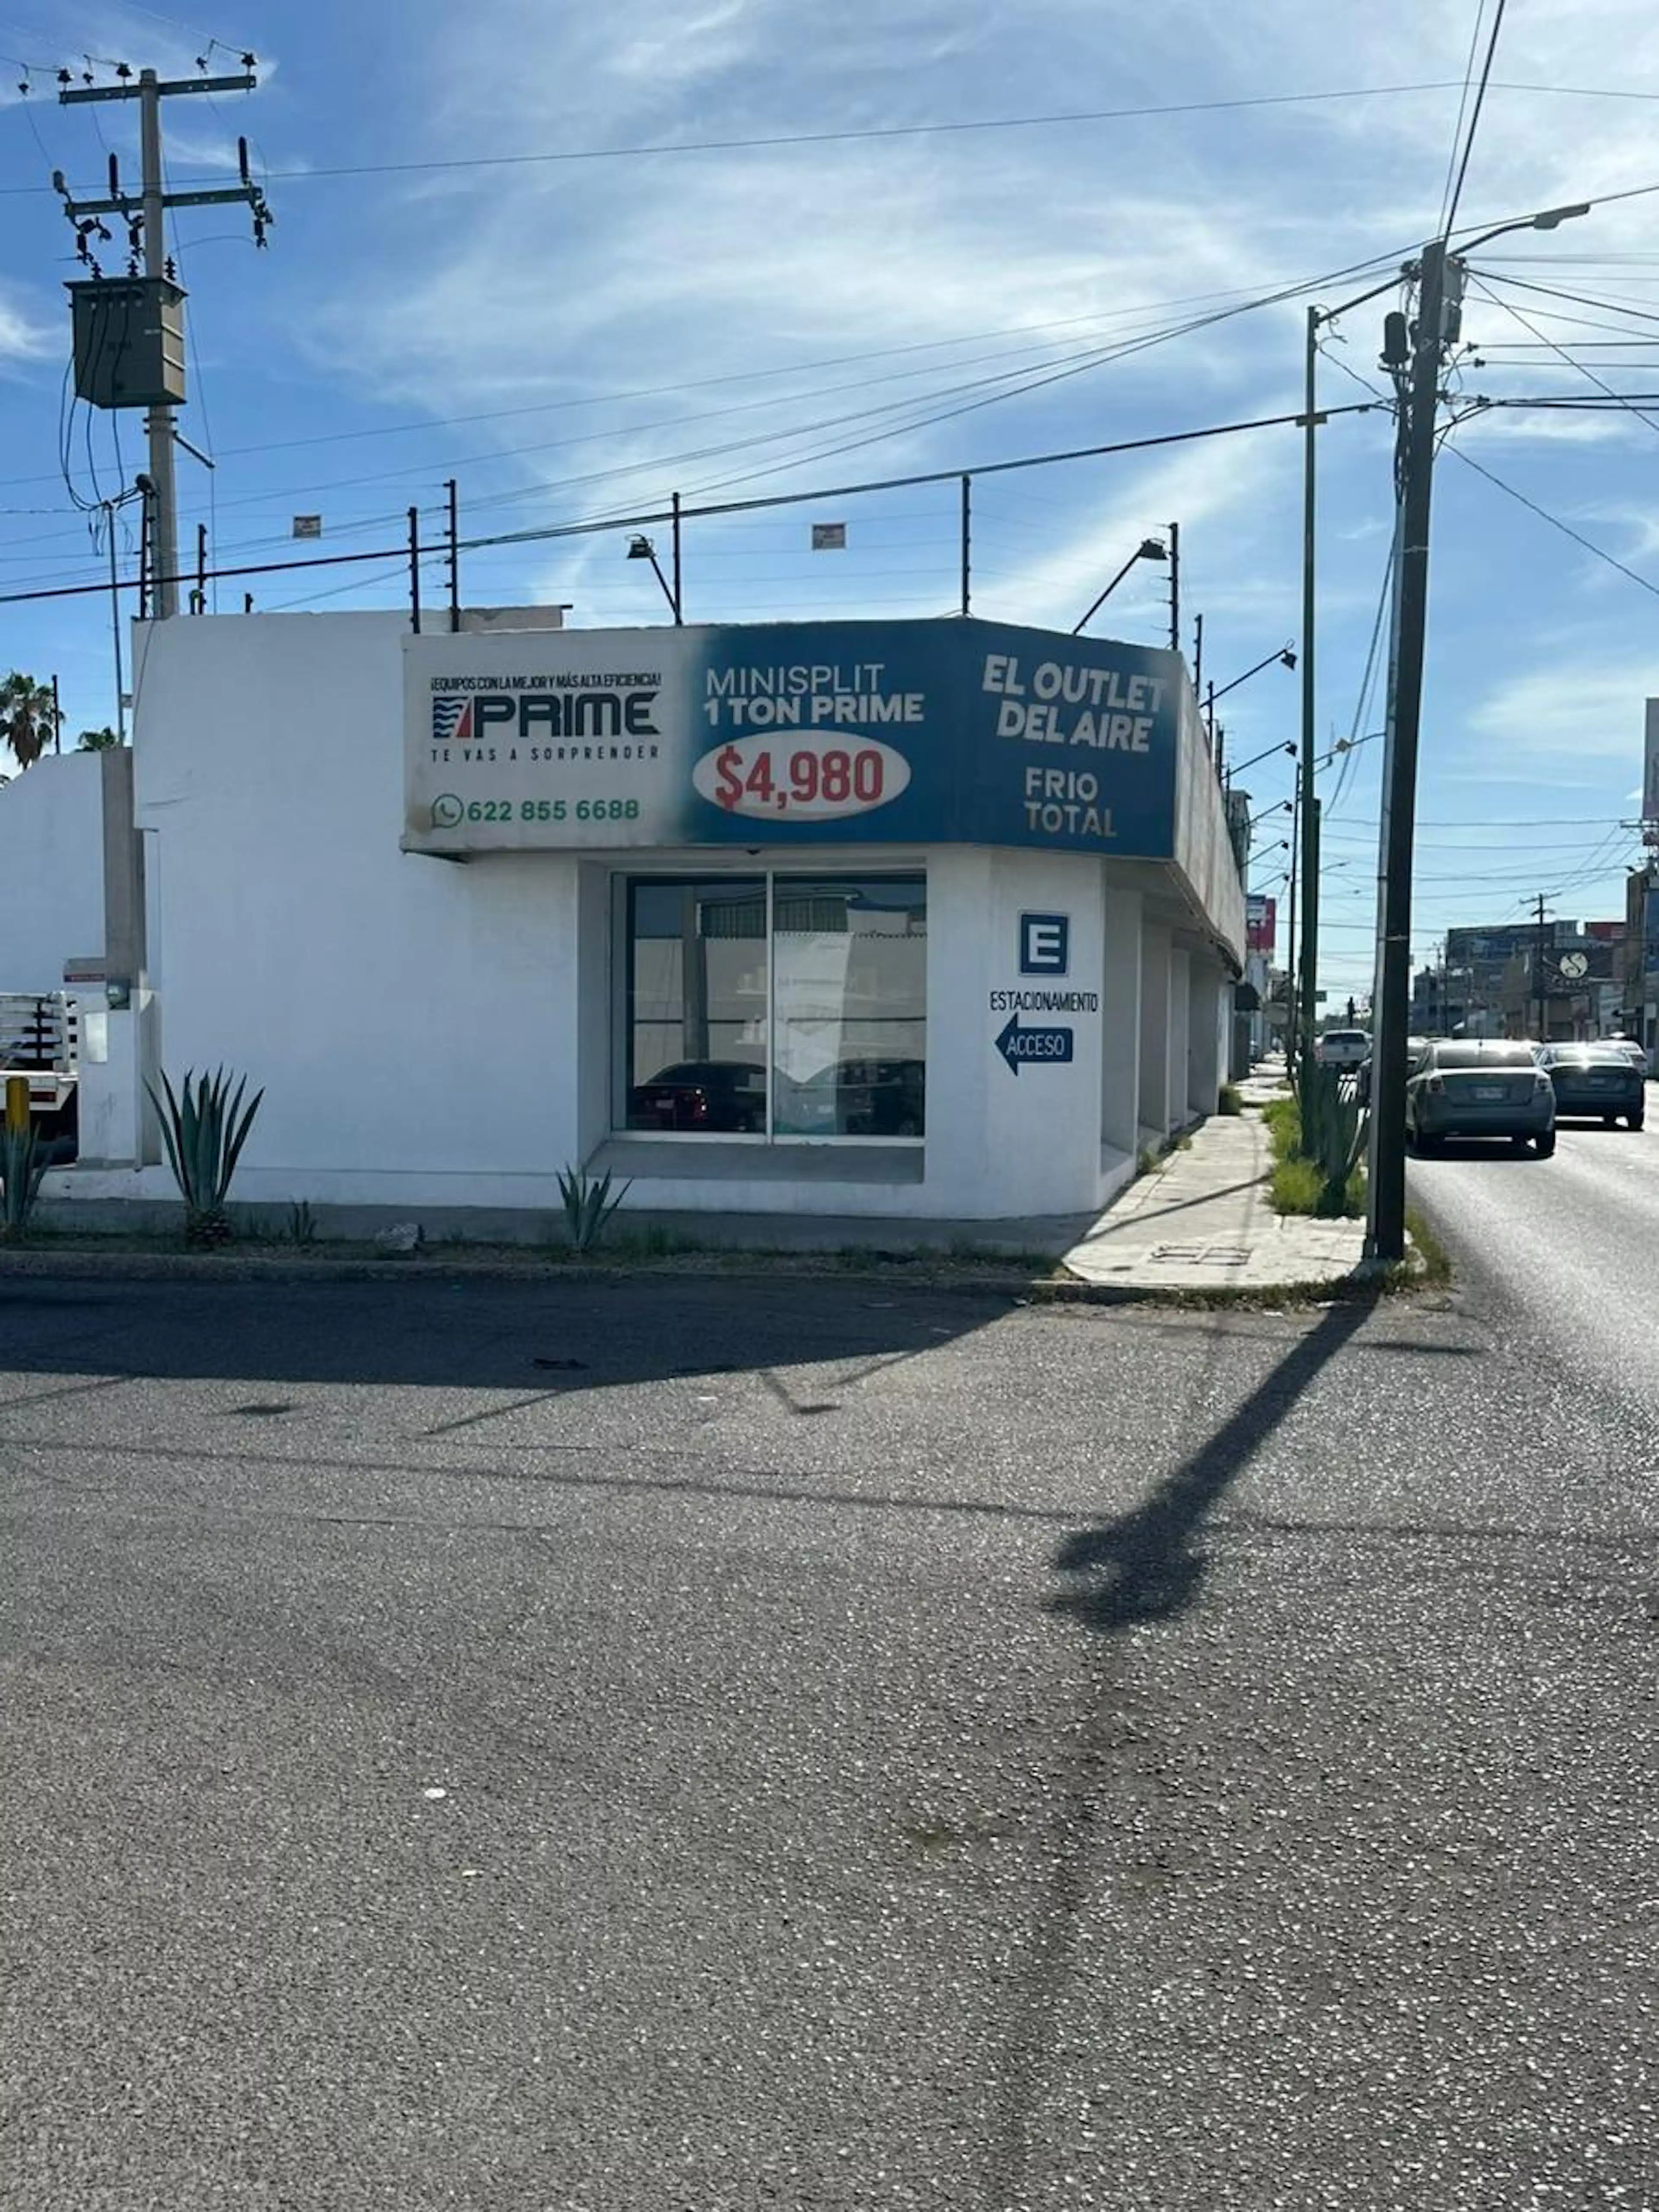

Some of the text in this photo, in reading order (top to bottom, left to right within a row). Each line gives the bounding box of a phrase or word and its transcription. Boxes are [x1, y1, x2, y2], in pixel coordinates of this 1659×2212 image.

[477, 677, 498, 690] CON
[499, 677, 511, 690] LA
[512, 675, 546, 690] MEJOR
[547, 675, 554, 689] Y
[581, 674, 604, 687] ALTA
[707, 664, 885, 696] MINISPLIT
[982, 654, 1165, 712] EL OUTLET
[474, 692, 661, 737] PRIME
[704, 693, 925, 725] 1 TON PRIME
[997, 699, 1153, 753] DEL AIRE
[432, 745, 658, 762] TE VAS A SORPRENDER
[715, 745, 884, 810] $4,980
[1025, 766, 1098, 801] FRIO
[467, 799, 639, 821] 622 855 6688
[1024, 801, 1117, 837] TOTAL
[1029, 924, 1060, 963] E
[990, 992, 1097, 1011] ESTACIONAMIENTO
[1006, 1035, 1065, 1055] ACCESO
